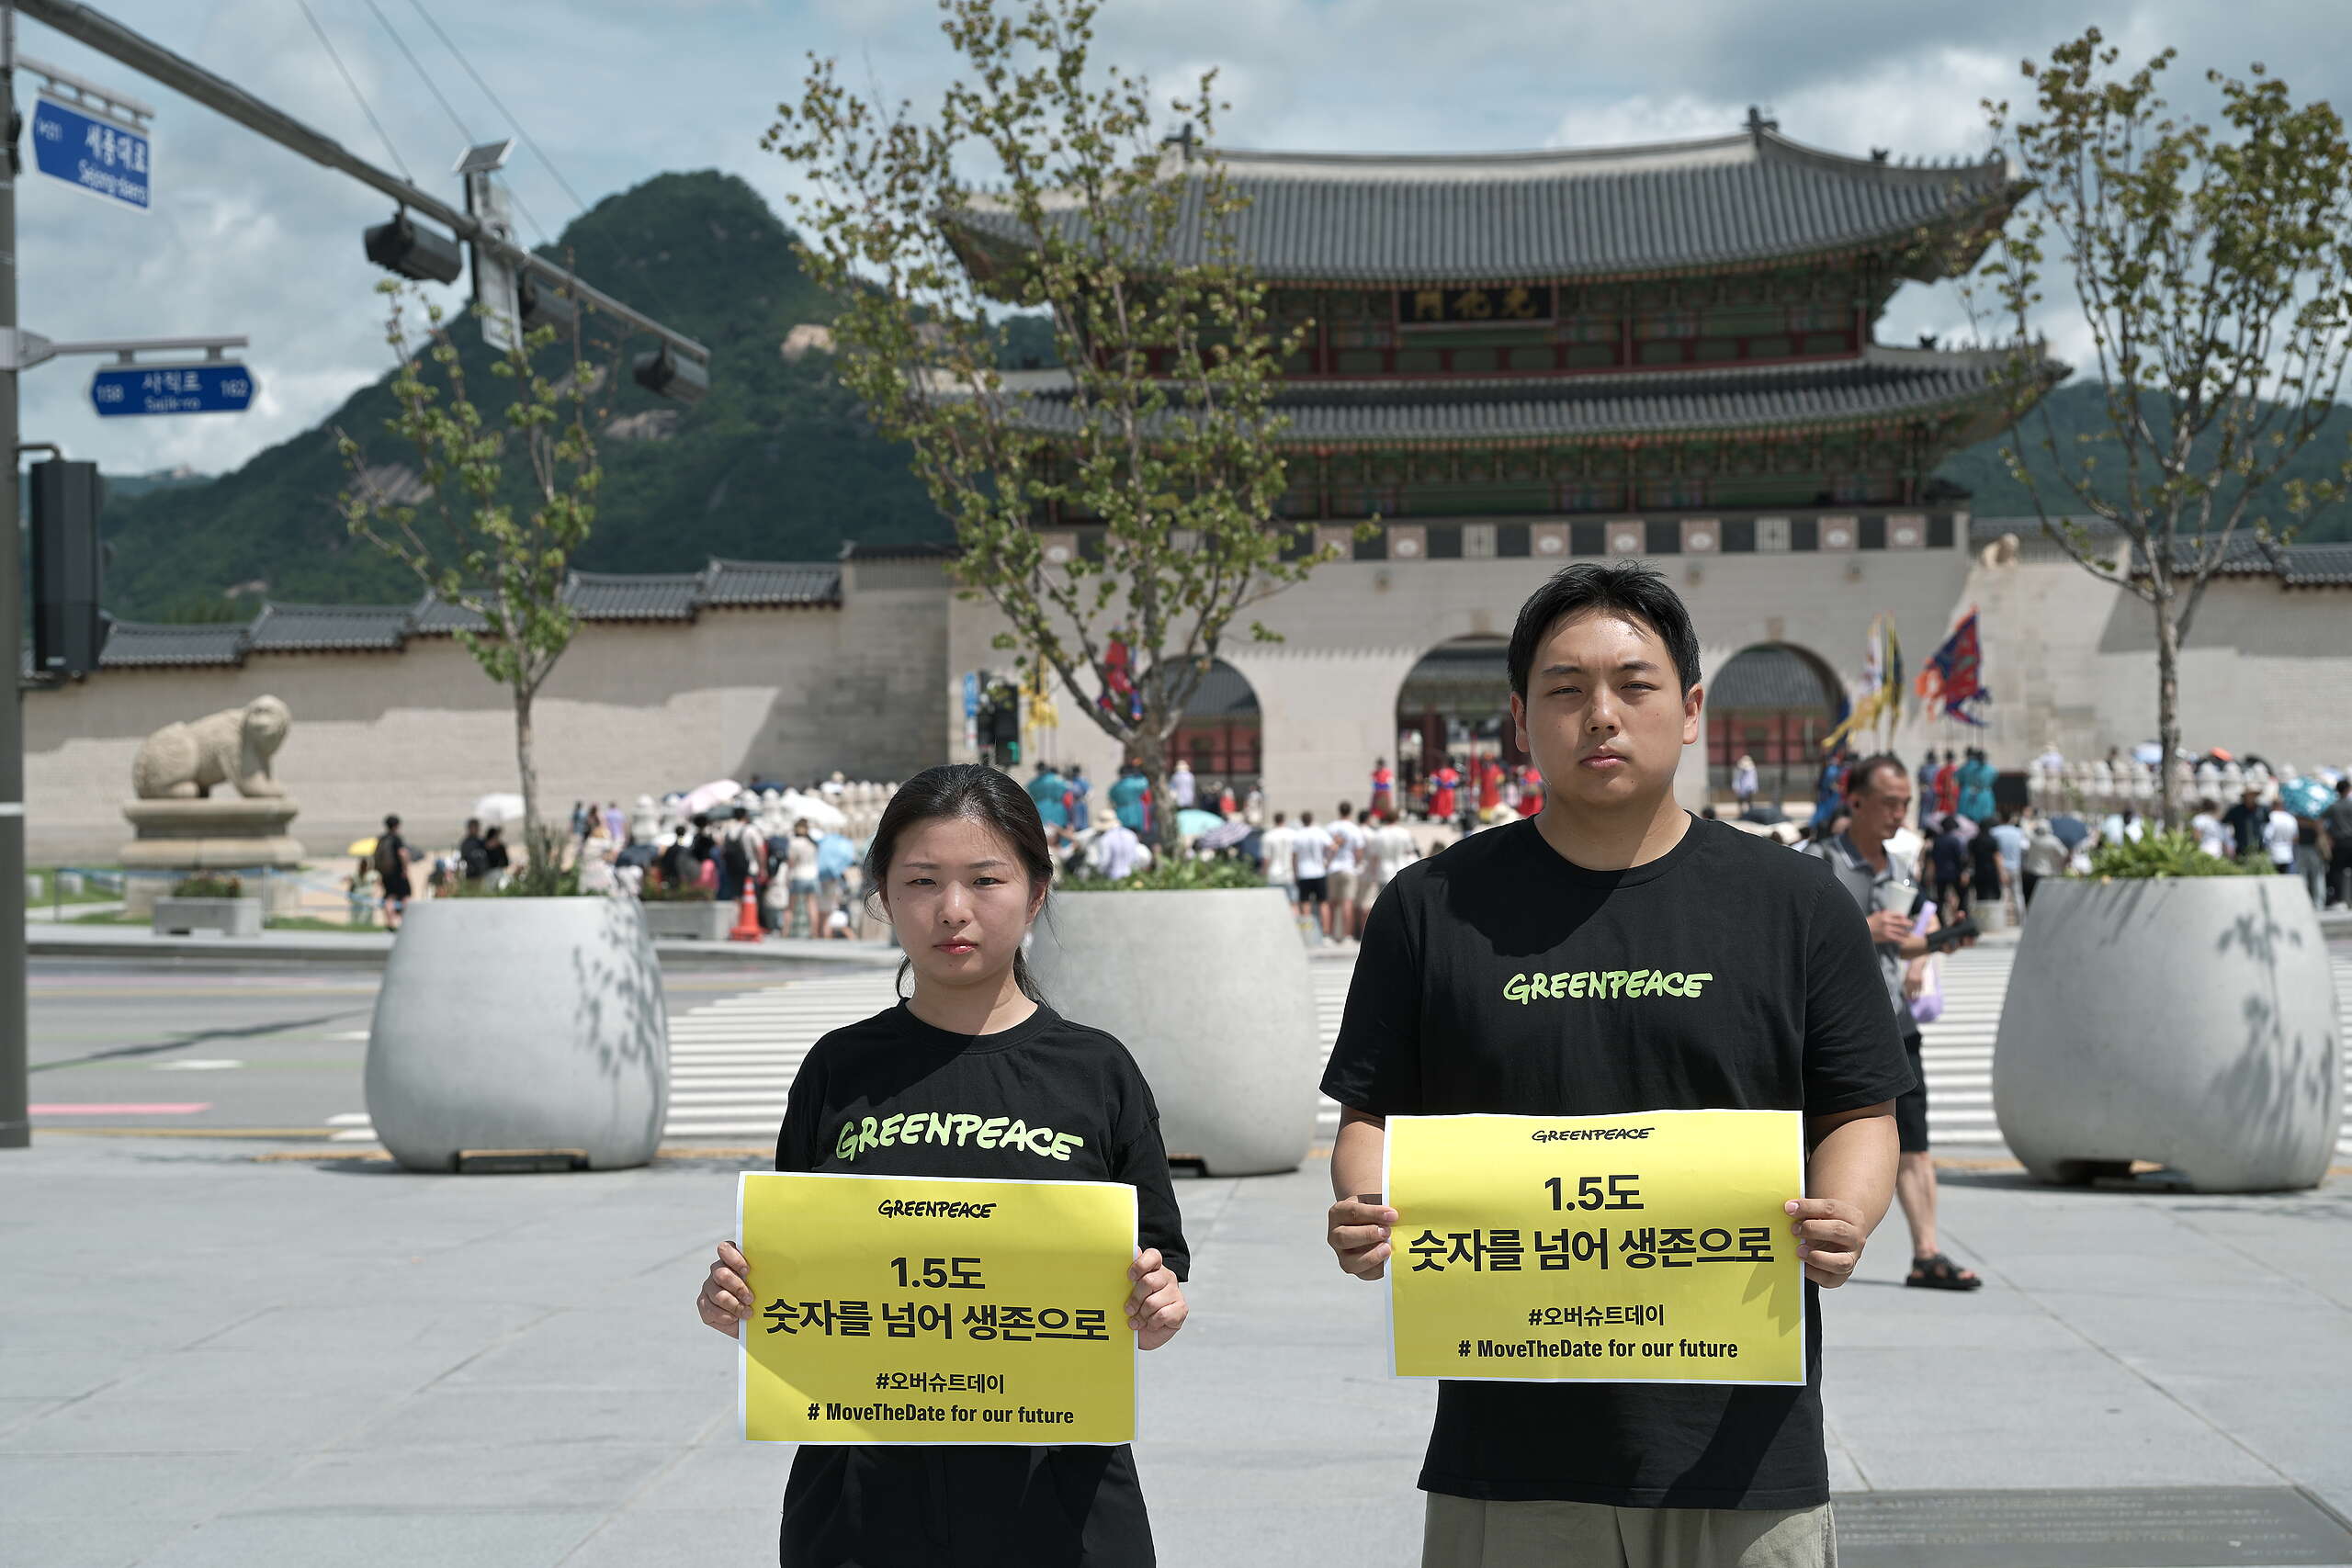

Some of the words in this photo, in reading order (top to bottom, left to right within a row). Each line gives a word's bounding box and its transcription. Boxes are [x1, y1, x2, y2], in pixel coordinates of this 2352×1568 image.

[141, 371, 203, 394] 사직로
[1503, 969, 1713, 1006] GREENPEACE
[835, 1112, 1084, 1163] GREENPEACE
[1532, 1127, 1655, 1143] GREENPEACE
[1544, 1174, 1645, 1212] 1.5도
[877, 1199, 997, 1219] GREENPEACE
[1408, 1228, 1525, 1273] 숫자를
[1533, 1228, 1609, 1270] 넘어
[1618, 1226, 1775, 1270] 생존으로
[890, 1257, 986, 1290] 1.5도
[763, 1298, 874, 1337] 숫자를
[882, 1301, 954, 1340] 넘어
[961, 1303, 1110, 1342] 생존으로
[1528, 1304, 1665, 1326] #오버슈트데이
[1458, 1340, 1472, 1359] #
[1477, 1338, 1603, 1359] MoveTheDate
[1608, 1338, 1636, 1359] for
[1641, 1342, 1674, 1359] our
[1679, 1338, 1738, 1359] future
[875, 1372, 1004, 1394] #오버슈트데이
[808, 1403, 820, 1421] #
[827, 1402, 945, 1422] MoveTheDate
[950, 1404, 978, 1423] for
[982, 1408, 1012, 1424] our
[1017, 1405, 1074, 1425] future
